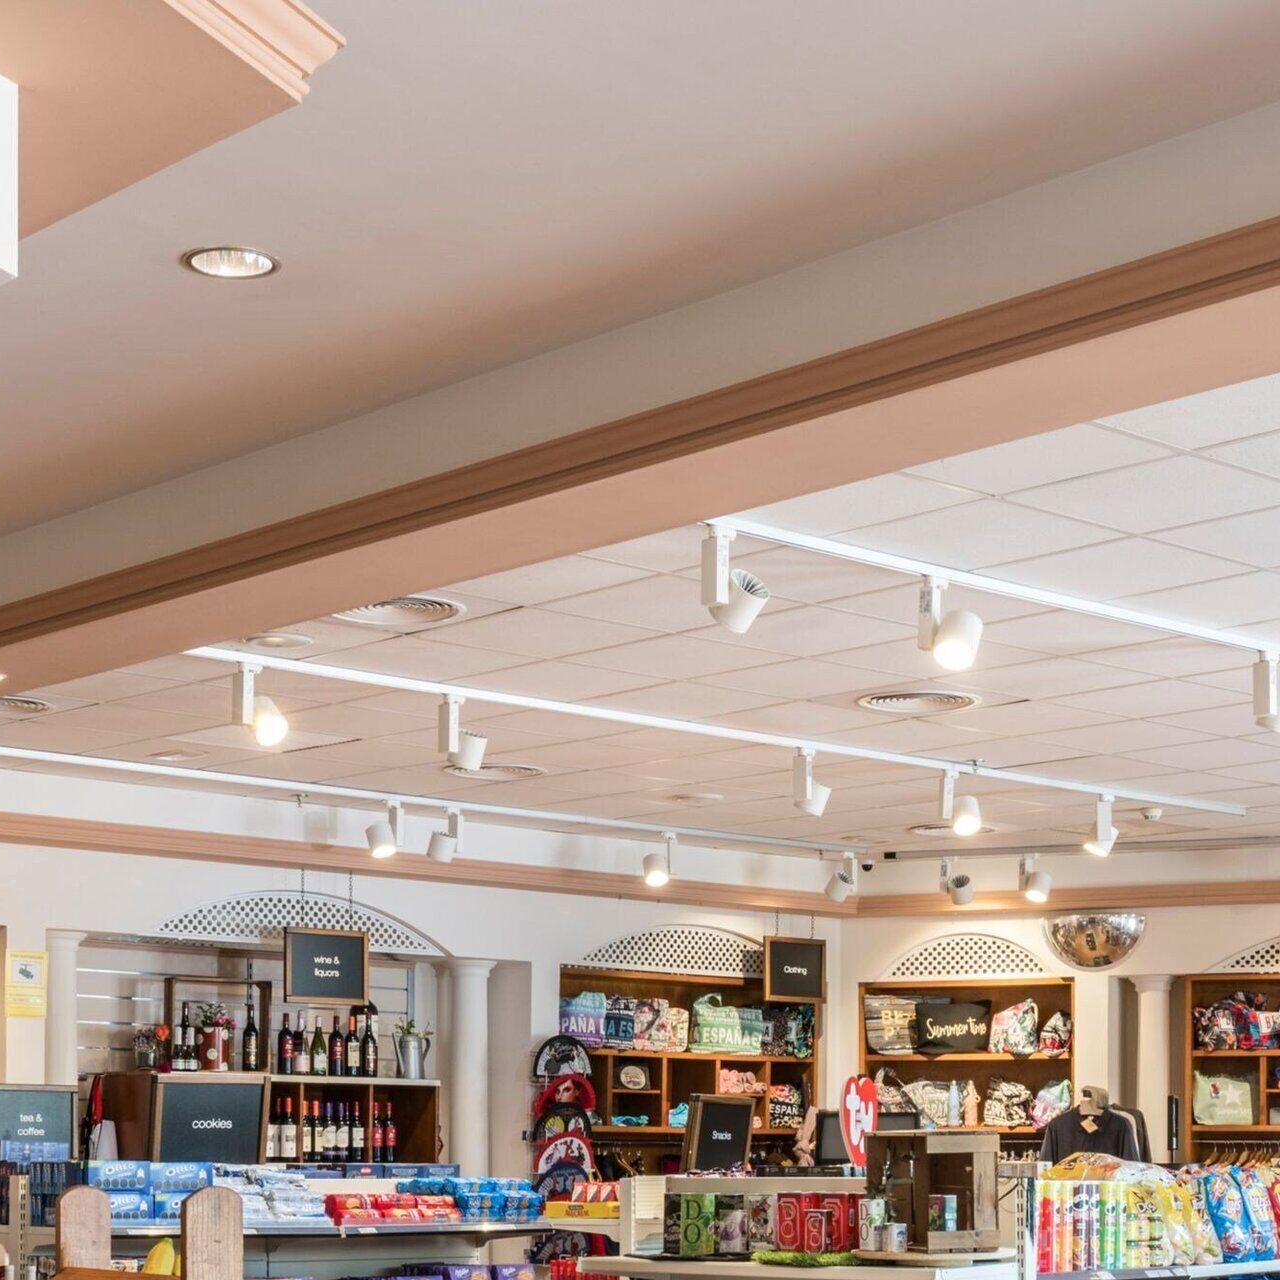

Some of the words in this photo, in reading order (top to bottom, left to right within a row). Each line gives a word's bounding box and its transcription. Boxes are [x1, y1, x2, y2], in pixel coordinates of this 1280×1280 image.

[314, 956, 331, 965] wine
[333, 955, 340, 965] &
[314, 968, 340, 978] liquors
[783, 965, 807, 976] Clothing
[926, 1017, 967, 1040] Summer
[20, 1113, 35, 1123] tea
[36, 1113, 44, 1123] &
[192, 1118, 233, 1130] cookies
[17, 1127, 46, 1138] coffee
[711, 1129, 732, 1141] Snacks
